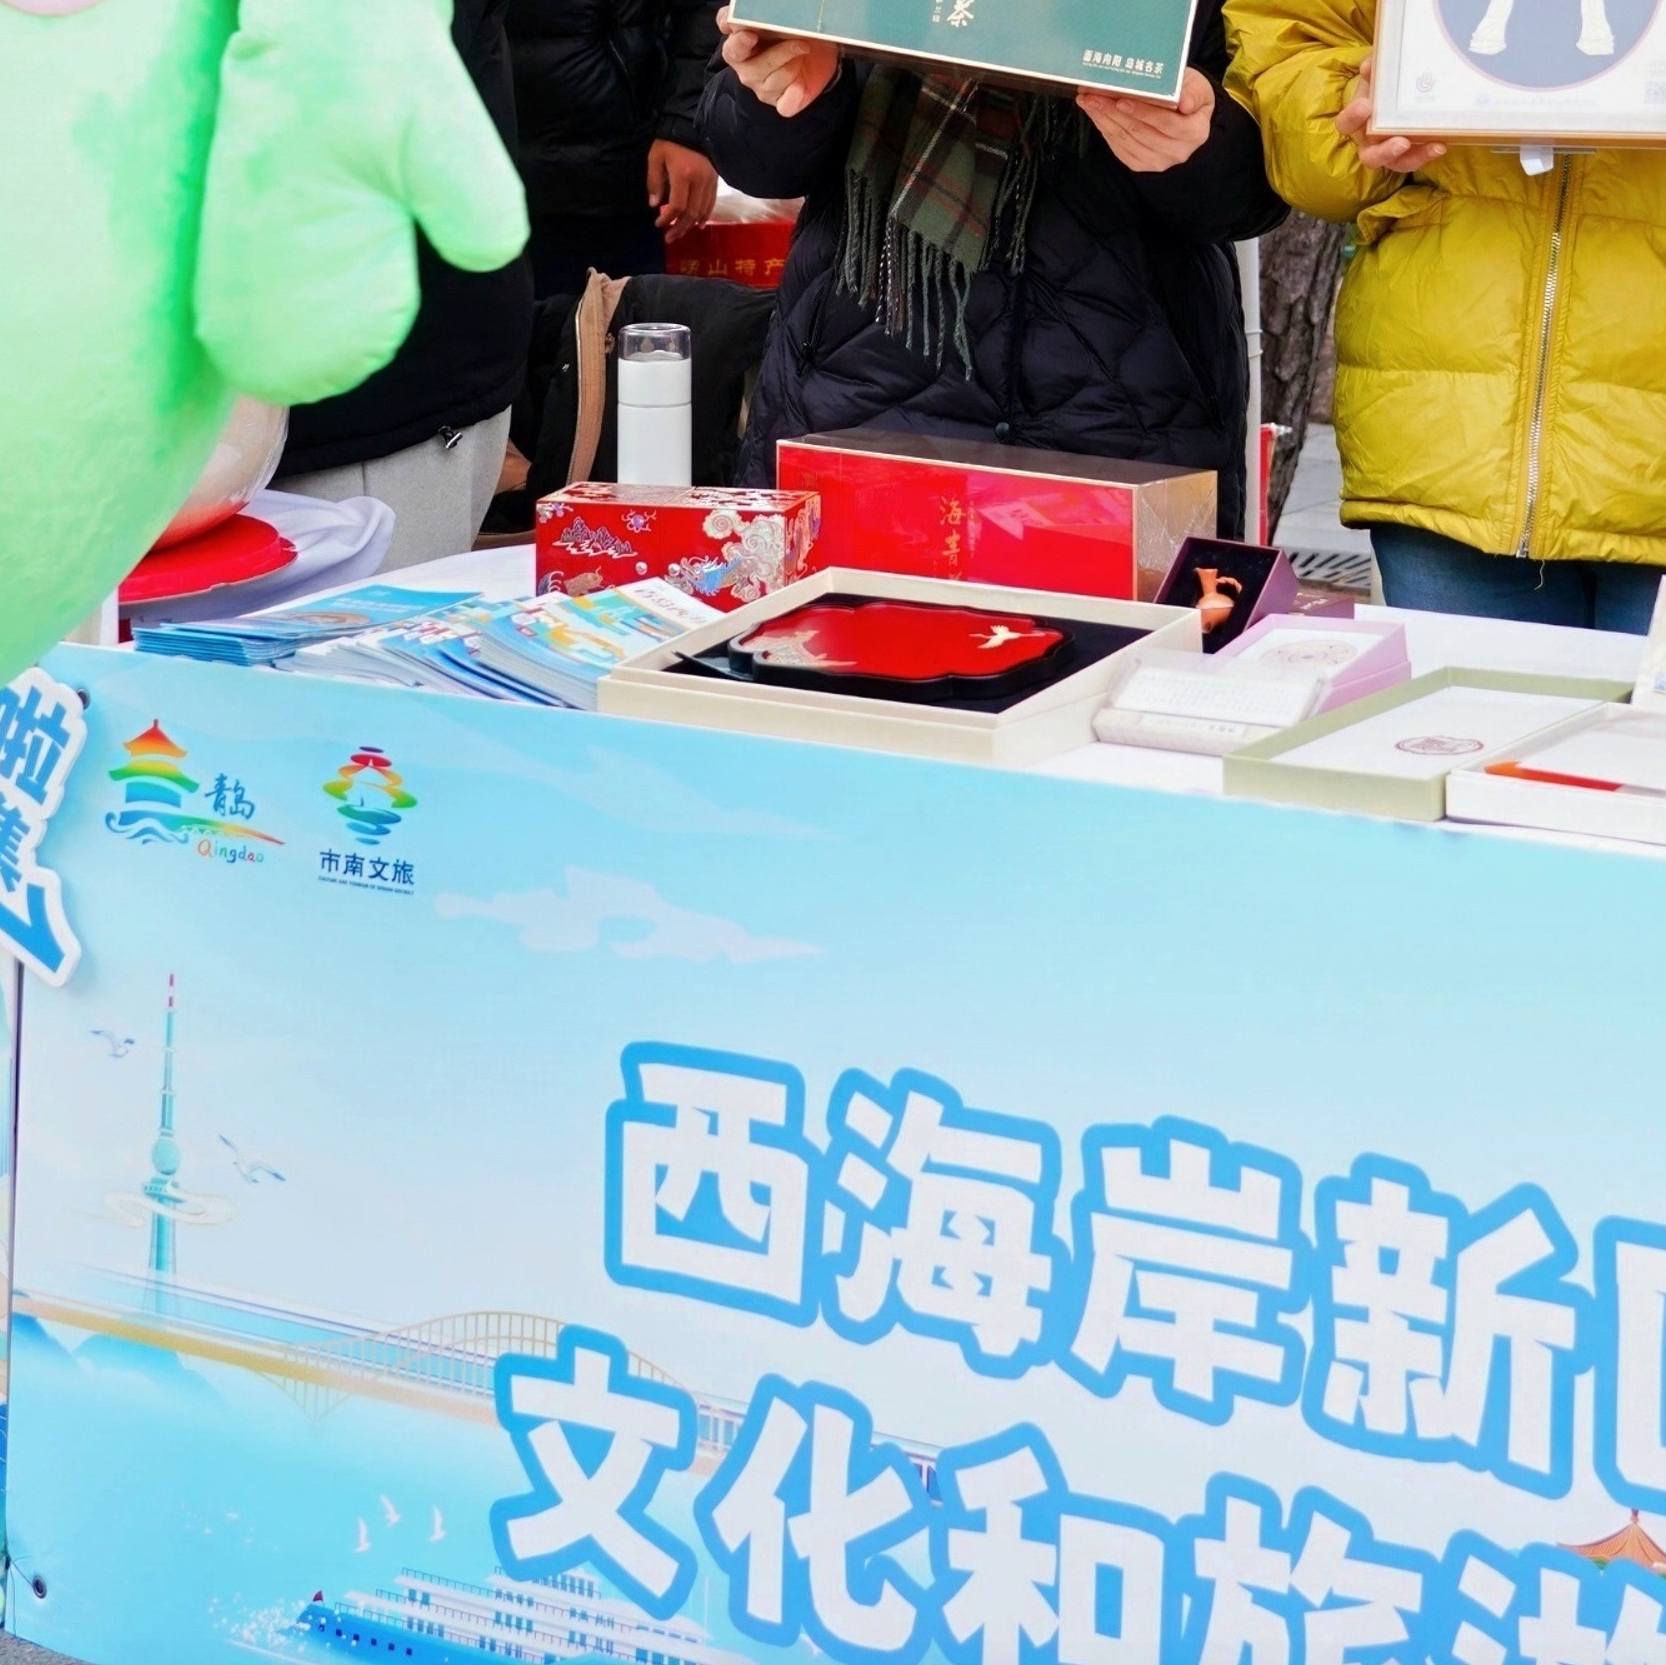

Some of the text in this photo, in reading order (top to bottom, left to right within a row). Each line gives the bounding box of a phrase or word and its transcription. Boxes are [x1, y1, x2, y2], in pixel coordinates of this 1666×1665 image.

[680, 258, 785, 276] 崂山特产
[938, 496, 966, 581] 海青
[204, 774, 256, 819] 青岛
[197, 839, 265, 864] Qingdao
[319, 848, 415, 885] 市南文旅
